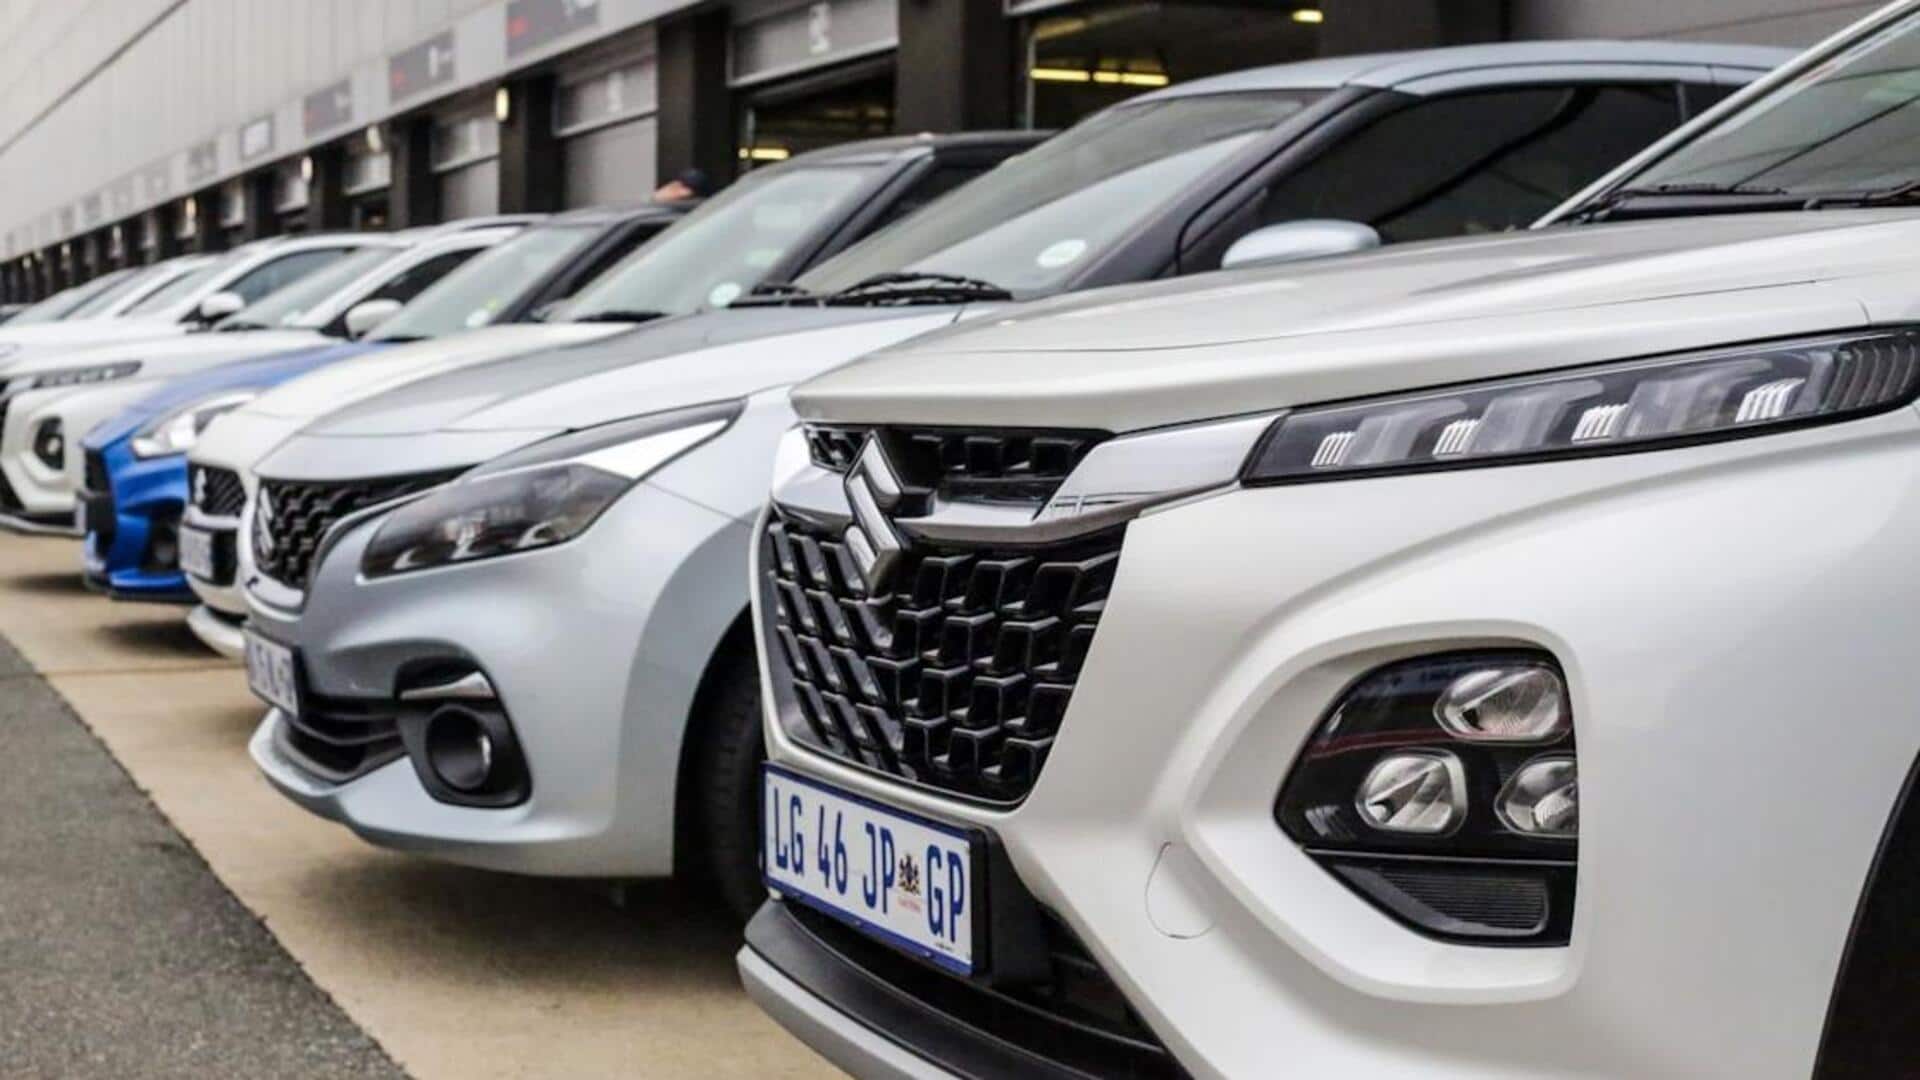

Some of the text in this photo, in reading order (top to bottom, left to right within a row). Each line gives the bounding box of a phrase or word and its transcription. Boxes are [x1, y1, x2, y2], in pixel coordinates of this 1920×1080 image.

[774, 787, 964, 942] LG 46 JP GP
